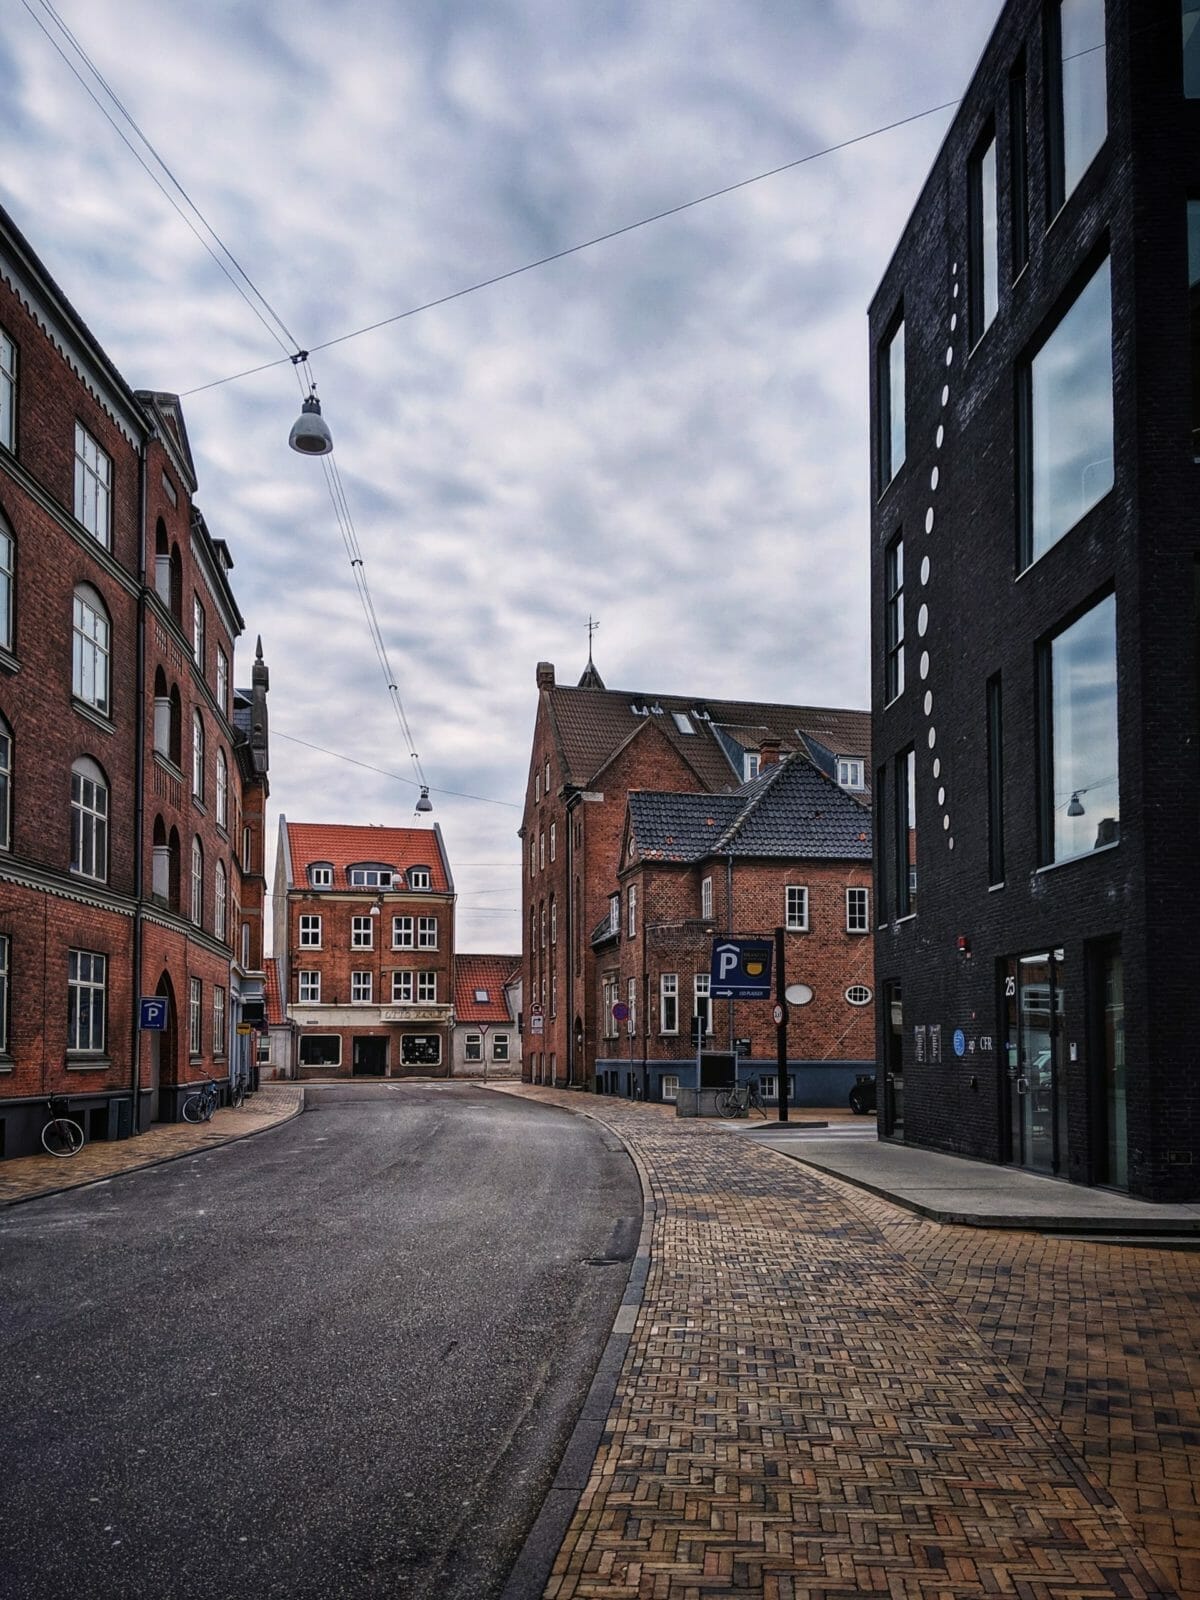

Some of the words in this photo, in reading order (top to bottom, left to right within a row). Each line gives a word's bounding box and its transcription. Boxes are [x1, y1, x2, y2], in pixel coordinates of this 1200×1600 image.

[719, 952, 738, 980] P
[1005, 976, 1016, 996] 25
[148, 1007, 159, 1022] P
[980, 1036, 993, 1051] CFR
